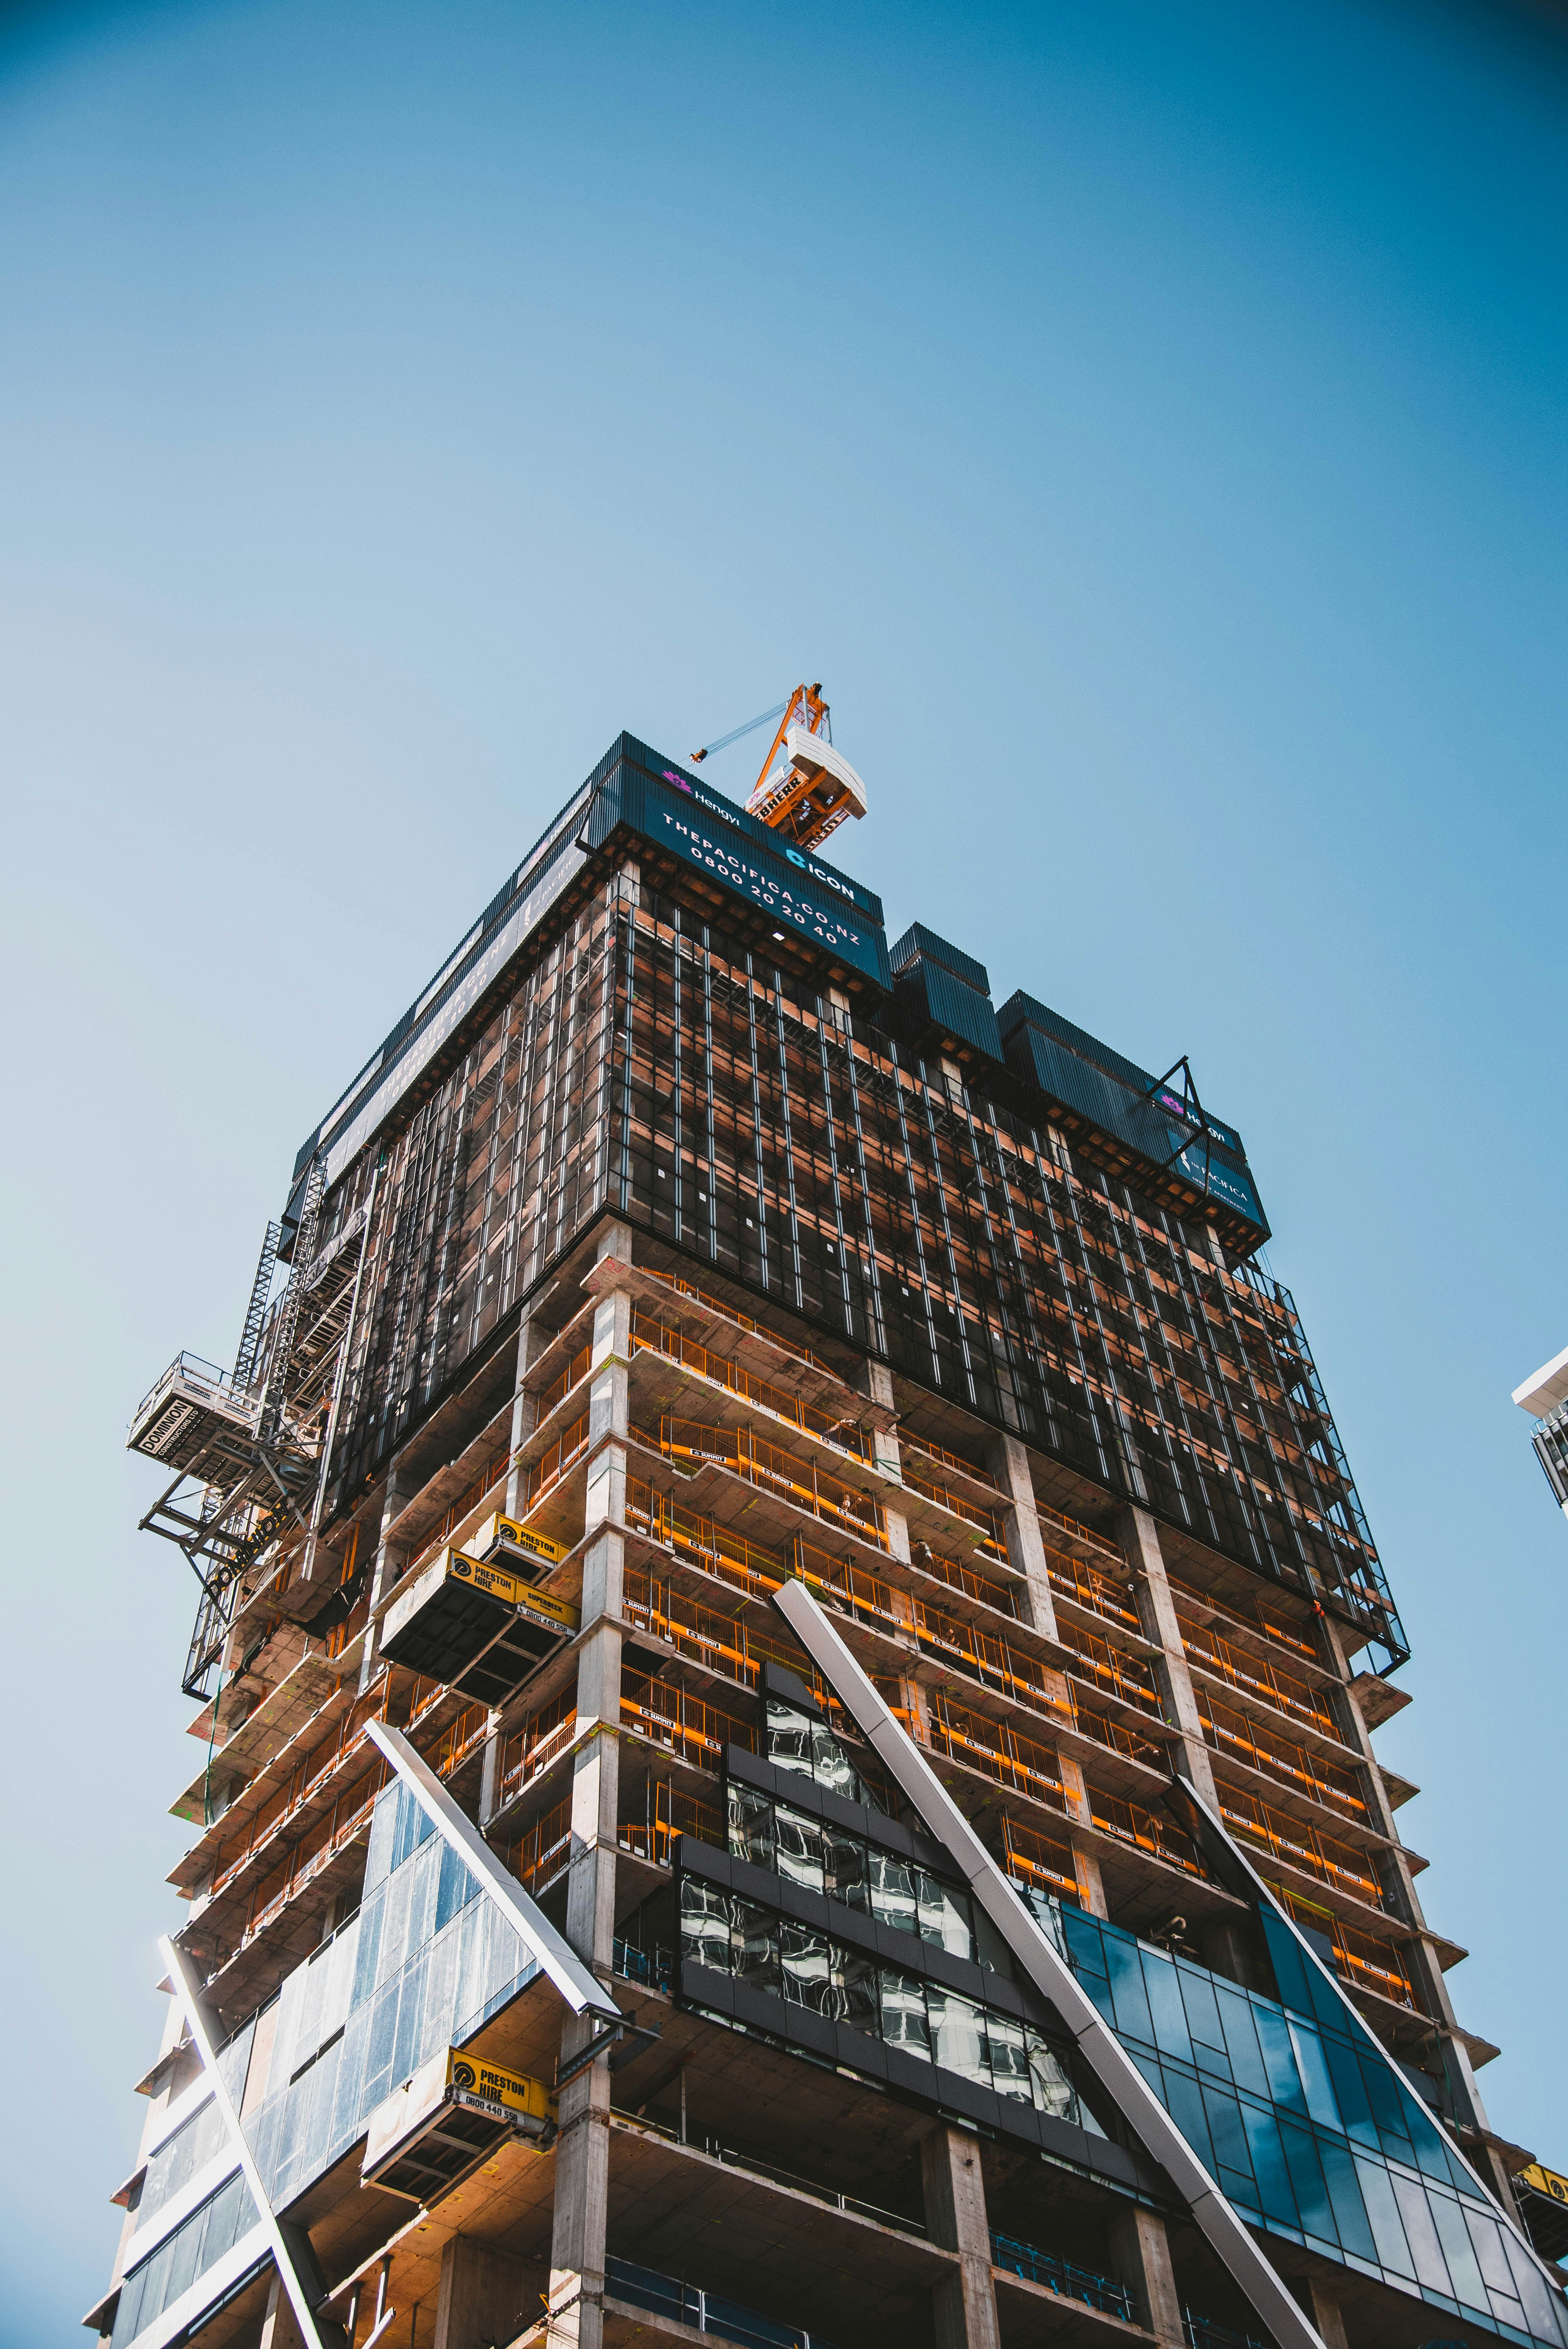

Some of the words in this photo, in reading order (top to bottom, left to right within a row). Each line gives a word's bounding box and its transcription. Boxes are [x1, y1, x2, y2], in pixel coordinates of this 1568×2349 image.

[695, 791, 739, 826] Hengyi
[551, 799, 582, 842] Hengyi
[663, 813, 860, 945] THEPACIFICA.CO.NZ
[809, 864, 855, 900] ICON
[691, 848, 743, 885] 0800
[752, 886, 774, 905] 20
[783, 905, 805, 924] 20
[814, 927, 837, 944] 40
[444, 934, 476, 980] ICON
[381, 933, 507, 1100] THEPACIFICA.CO.NZ
[392, 1052, 425, 1098] 0800
[429, 1027, 445, 1052] 20
[450, 1000, 465, 1025] 20
[472, 973, 488, 997] 40
[1187, 1112, 1225, 1142] Hegyi
[1201, 1167, 1247, 1201] PACIFICA
[1192, 1176, 1212, 1190] LUXUY
[1214, 1190, 1247, 1213] APARTMENTS
[185, 1383, 211, 1397] DOMINION
[225, 1403, 251, 1417] DOMINION
[141, 1402, 188, 1451] DOMINION
[158, 1417, 192, 1457] CONSTRUCTORS
[189, 1410, 199, 1421] LTD
[829, 1440, 846, 1452] SUMMIT
[701, 1452, 723, 1461] SUMMIT
[771, 1472, 789, 1485] SUMMIT
[845, 1514, 863, 1525] SUMMIT
[520, 1531, 555, 1554] PRESTON
[207, 1501, 290, 1601] DOMINION
[698, 1545, 718, 1556] SUMMT
[474, 1574, 493, 1591] HIRE
[475, 1565, 511, 1591] PRESTON
[1062, 1578, 1076, 1588] SUMMIT
[527, 1592, 563, 1614] SUPERDECK
[628, 1601, 649, 1613] SUMMIT
[1105, 1600, 1119, 1611] SUMMIT
[526, 1611, 542, 1623] 0800
[543, 1618, 555, 1628] 440
[556, 1624, 568, 1633] 558
[881, 1611, 899, 1622] SUMMIT
[697, 1634, 717, 1647] SUMMIT
[941, 1642, 960, 1654] SUMMIT
[987, 1665, 1003, 1675] SUMMIT
[1035, 1688, 1052, 1700] SUMMIT
[650, 1713, 672, 1726] SUMMIT
[974, 1743, 993, 1755] SUMMIT
[1036, 1773, 1054, 1785] SUMMIT
[1232, 1814, 1249, 1825] SUMMIT
[1117, 1829, 1134, 1840] SUMMIT
[549, 1837, 565, 1855] SUMMIT
[1166, 1852, 1182, 1863] SUMMIT
[1042, 1869, 1061, 1881] SUMMIT
[1370, 1965, 1387, 1976] SUMMIT
[481, 2069, 525, 2097] PRESTON
[479, 2082, 503, 2103] HIRE
[466, 2096, 485, 2110] 0800
[486, 2103, 502, 2116] 440
[504, 2110, 518, 2123] 558
